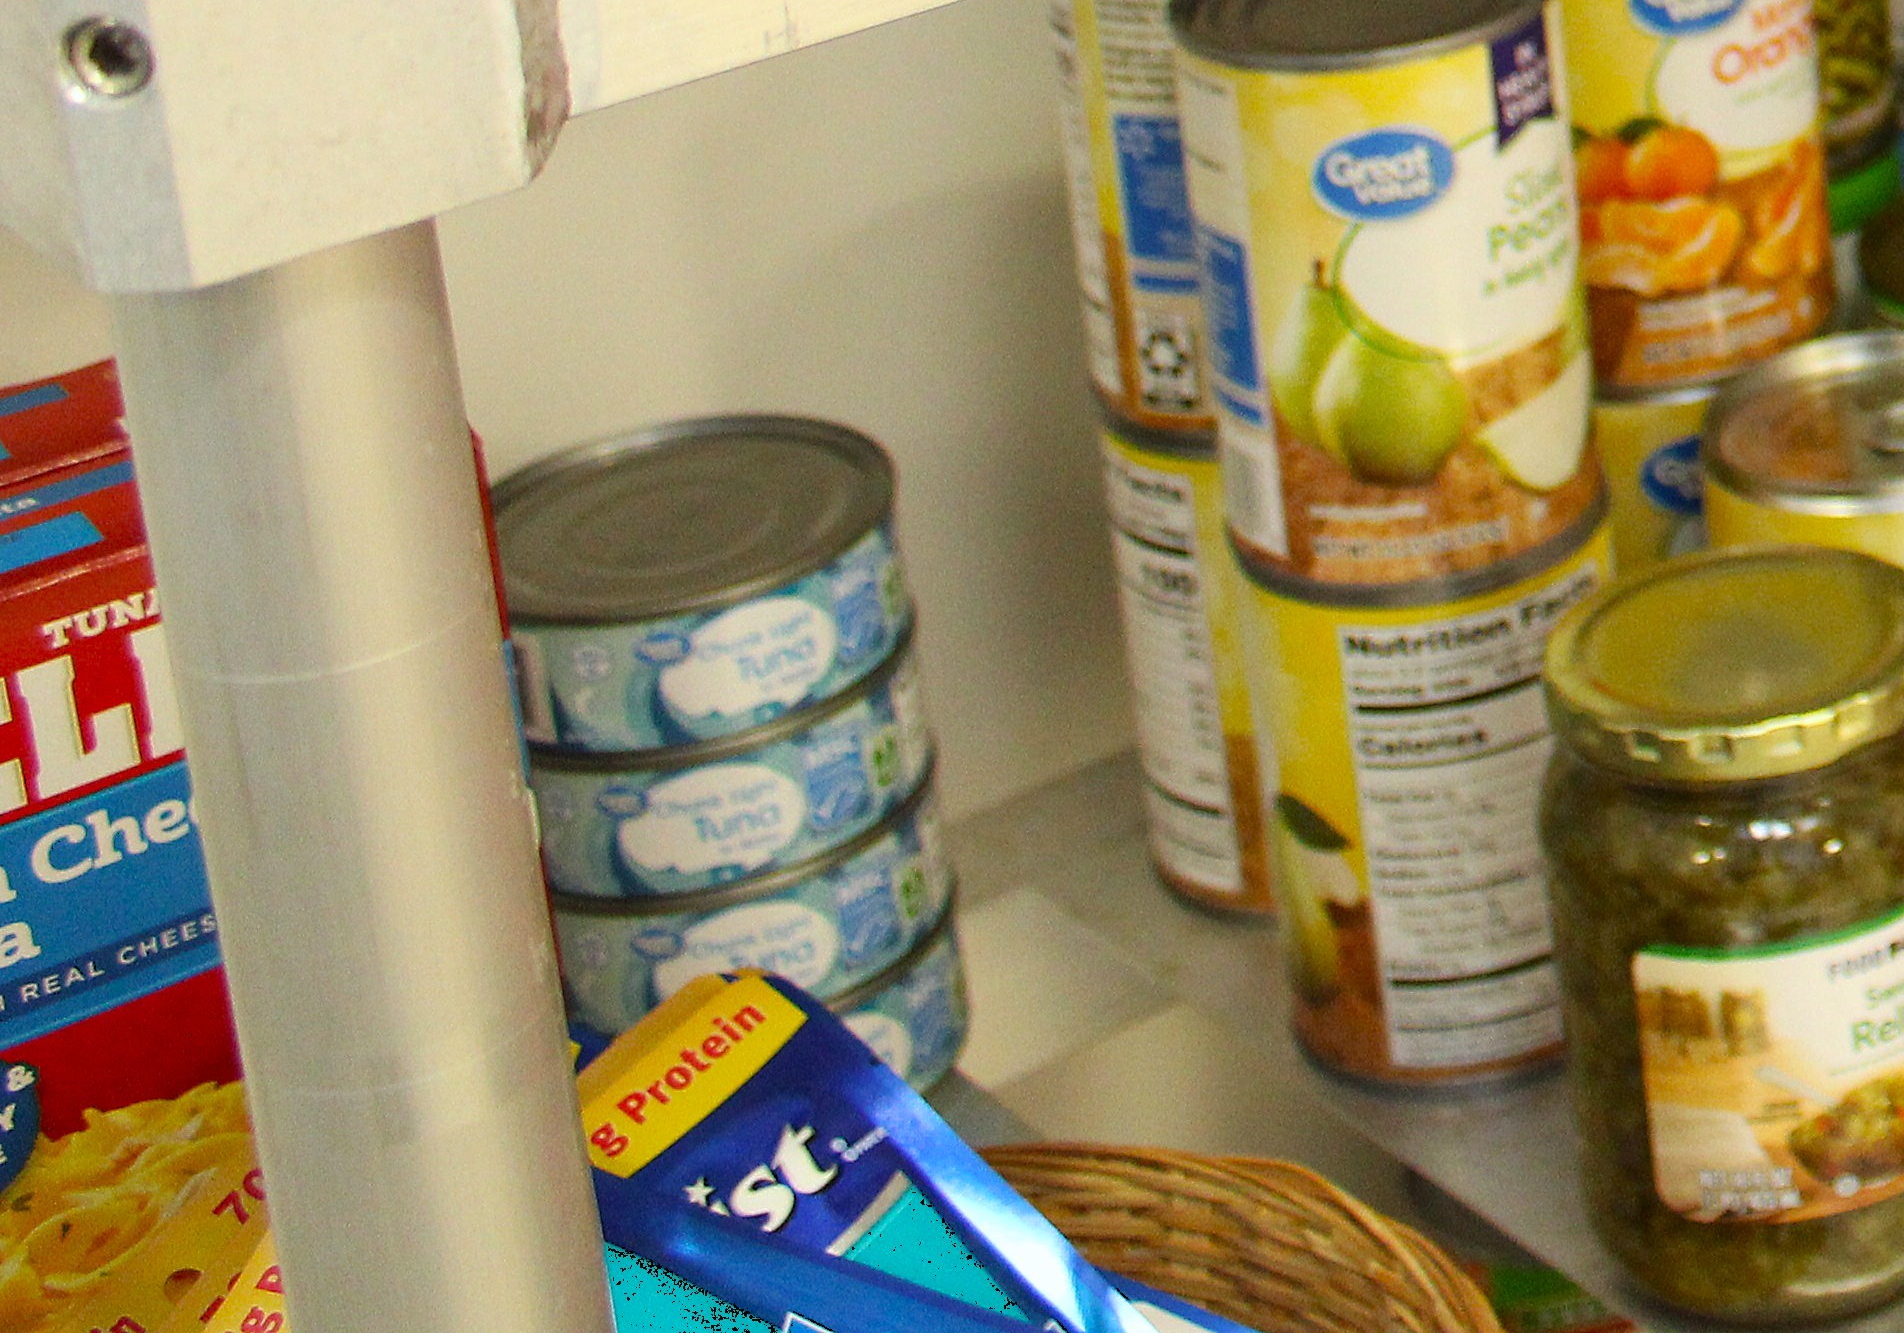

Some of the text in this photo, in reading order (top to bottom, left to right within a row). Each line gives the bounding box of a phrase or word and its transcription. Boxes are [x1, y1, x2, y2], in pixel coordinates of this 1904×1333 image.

[1713, 25, 1812, 85] Oran
[1325, 144, 1430, 189] Great
[1354, 178, 1433, 206] Value
[736, 637, 817, 682] Tuna
[1345, 618, 1512, 656] Nutrition
[1360, 729, 1490, 755] Calories
[31, 797, 201, 884] Che
[694, 802, 782, 843] Tuna
[20, 913, 219, 1003] REAL CHEES
[7, 1064, 35, 1093] &
[590, 1005, 767, 1158] g Protein
